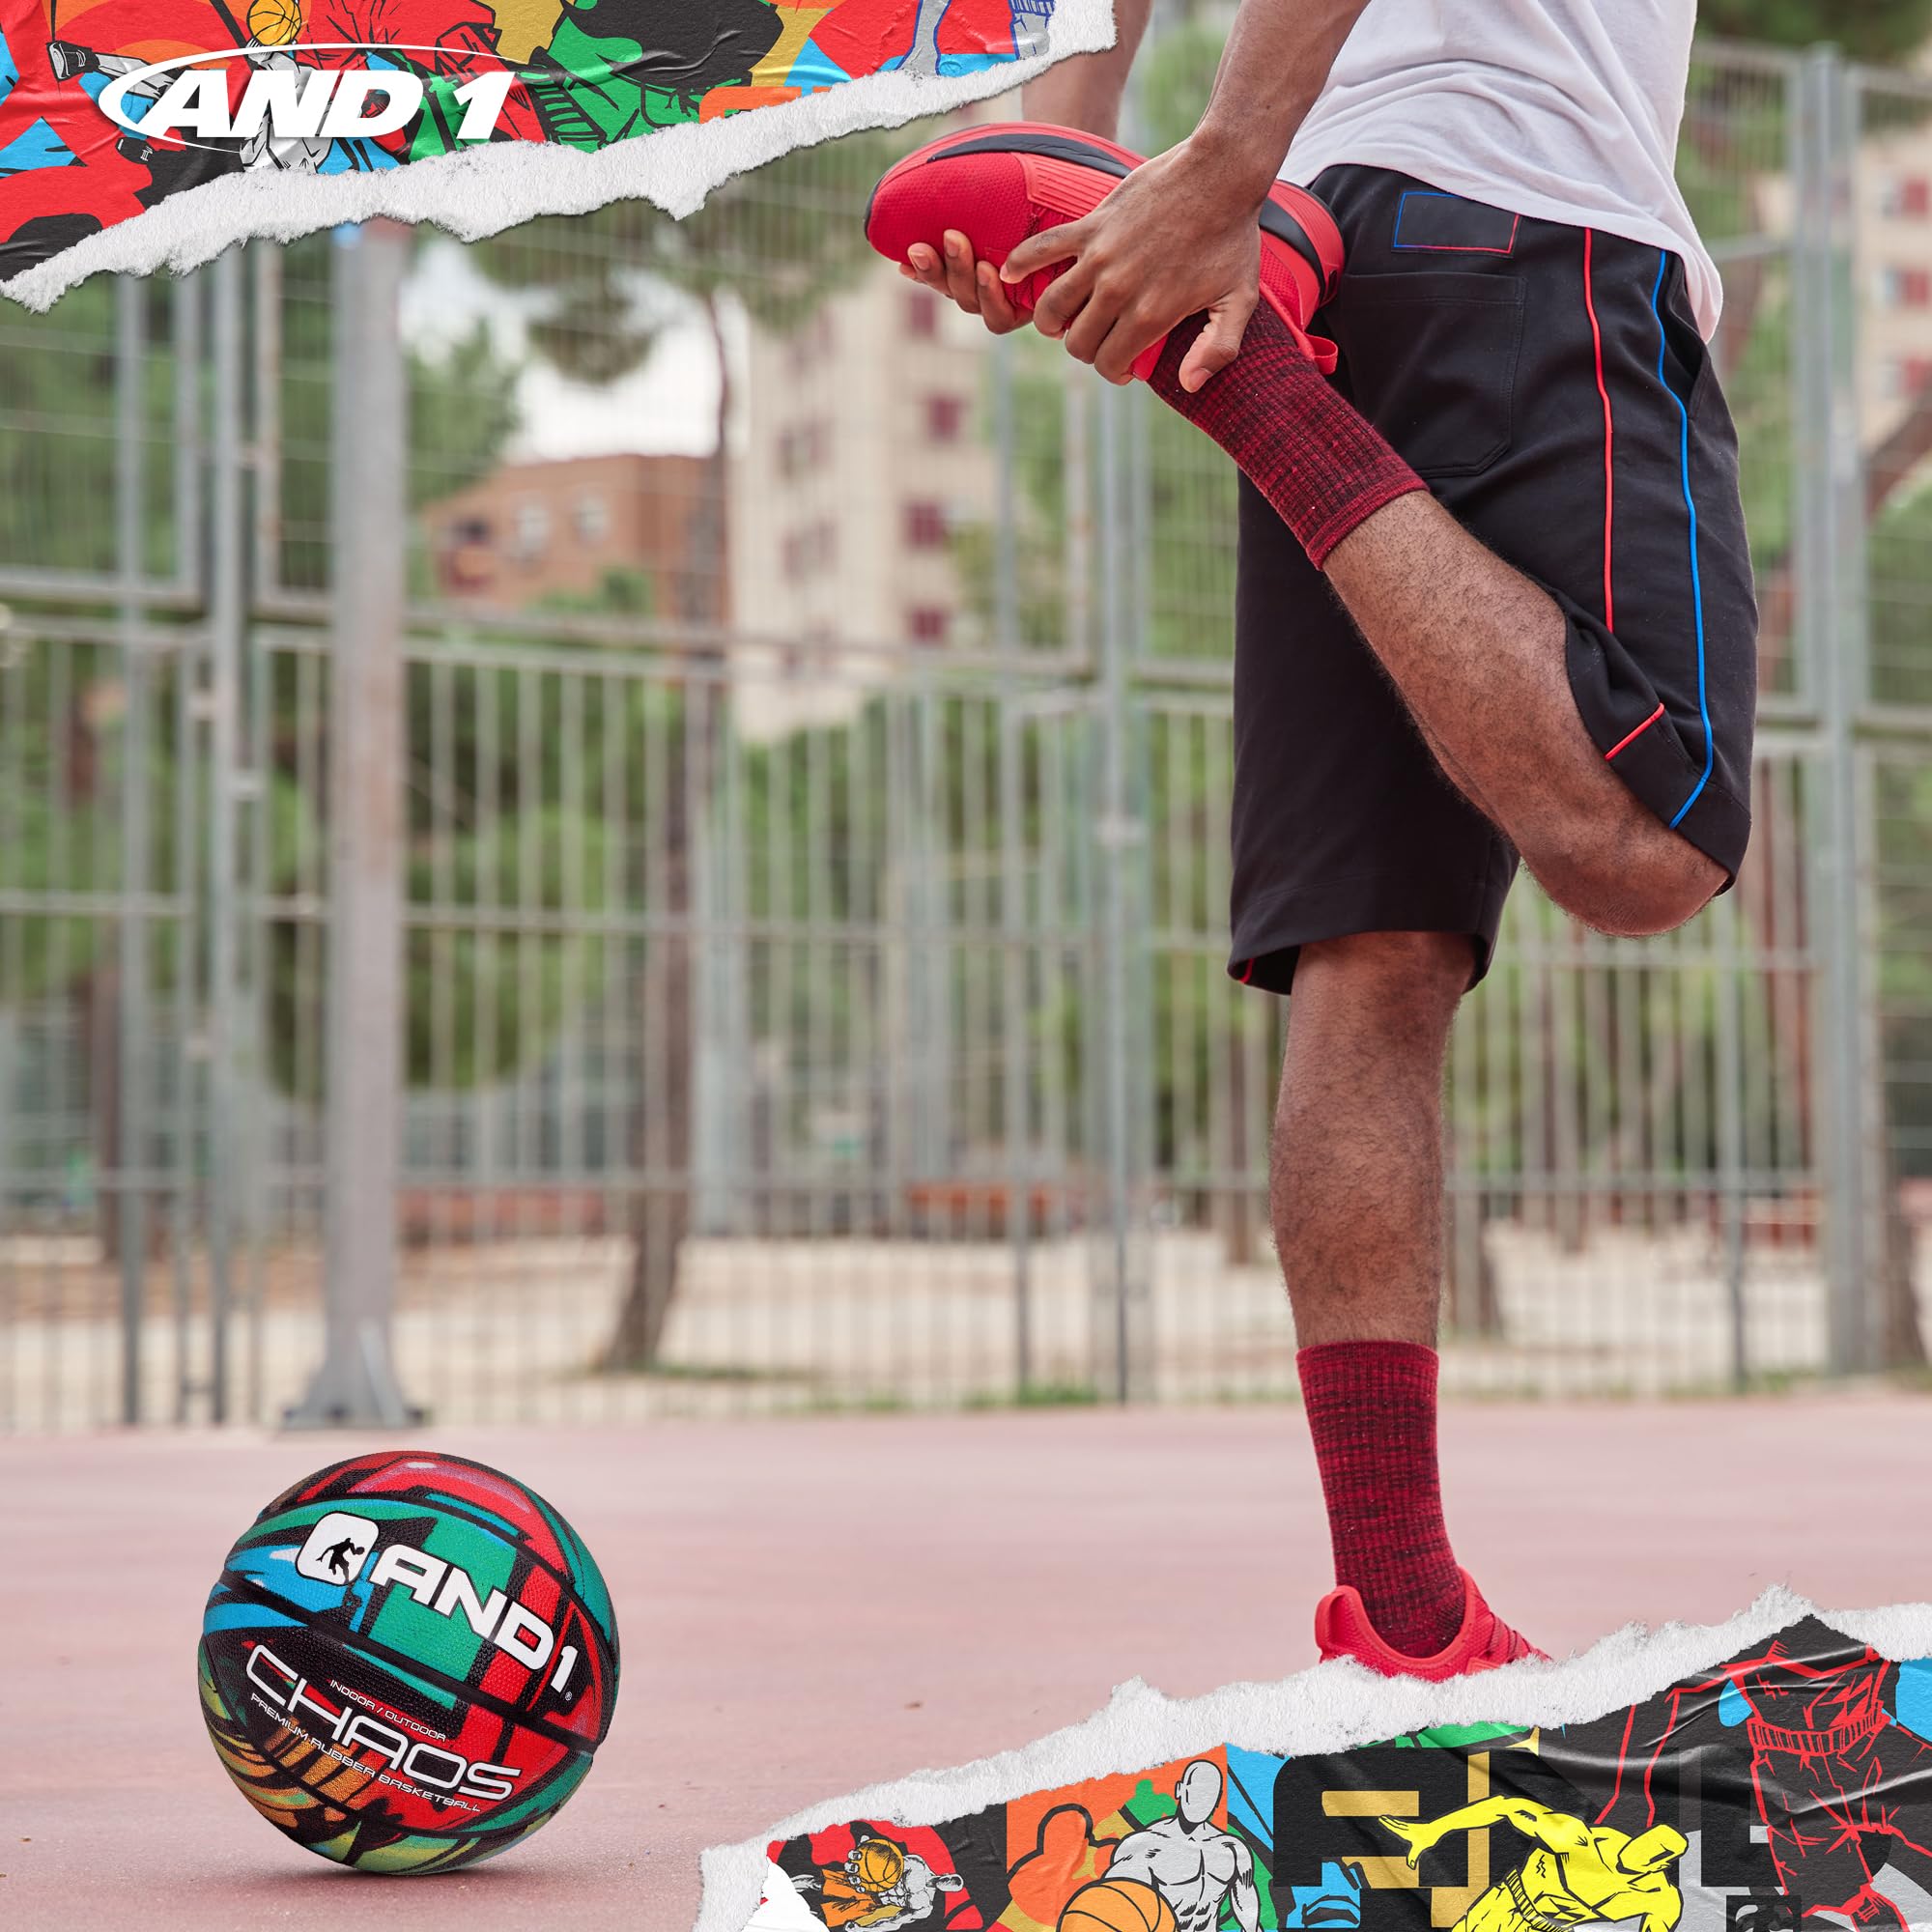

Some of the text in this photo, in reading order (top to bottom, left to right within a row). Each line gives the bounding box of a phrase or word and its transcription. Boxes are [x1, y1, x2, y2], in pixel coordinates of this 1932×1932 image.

[245, 1644, 523, 1800] CHAOS
[250, 1692, 482, 1812] PREMIUM RUBBER BASKETBALL
[329, 1679, 375, 1710] INDOOR
[384, 1710, 447, 1743] OUTDOOR
